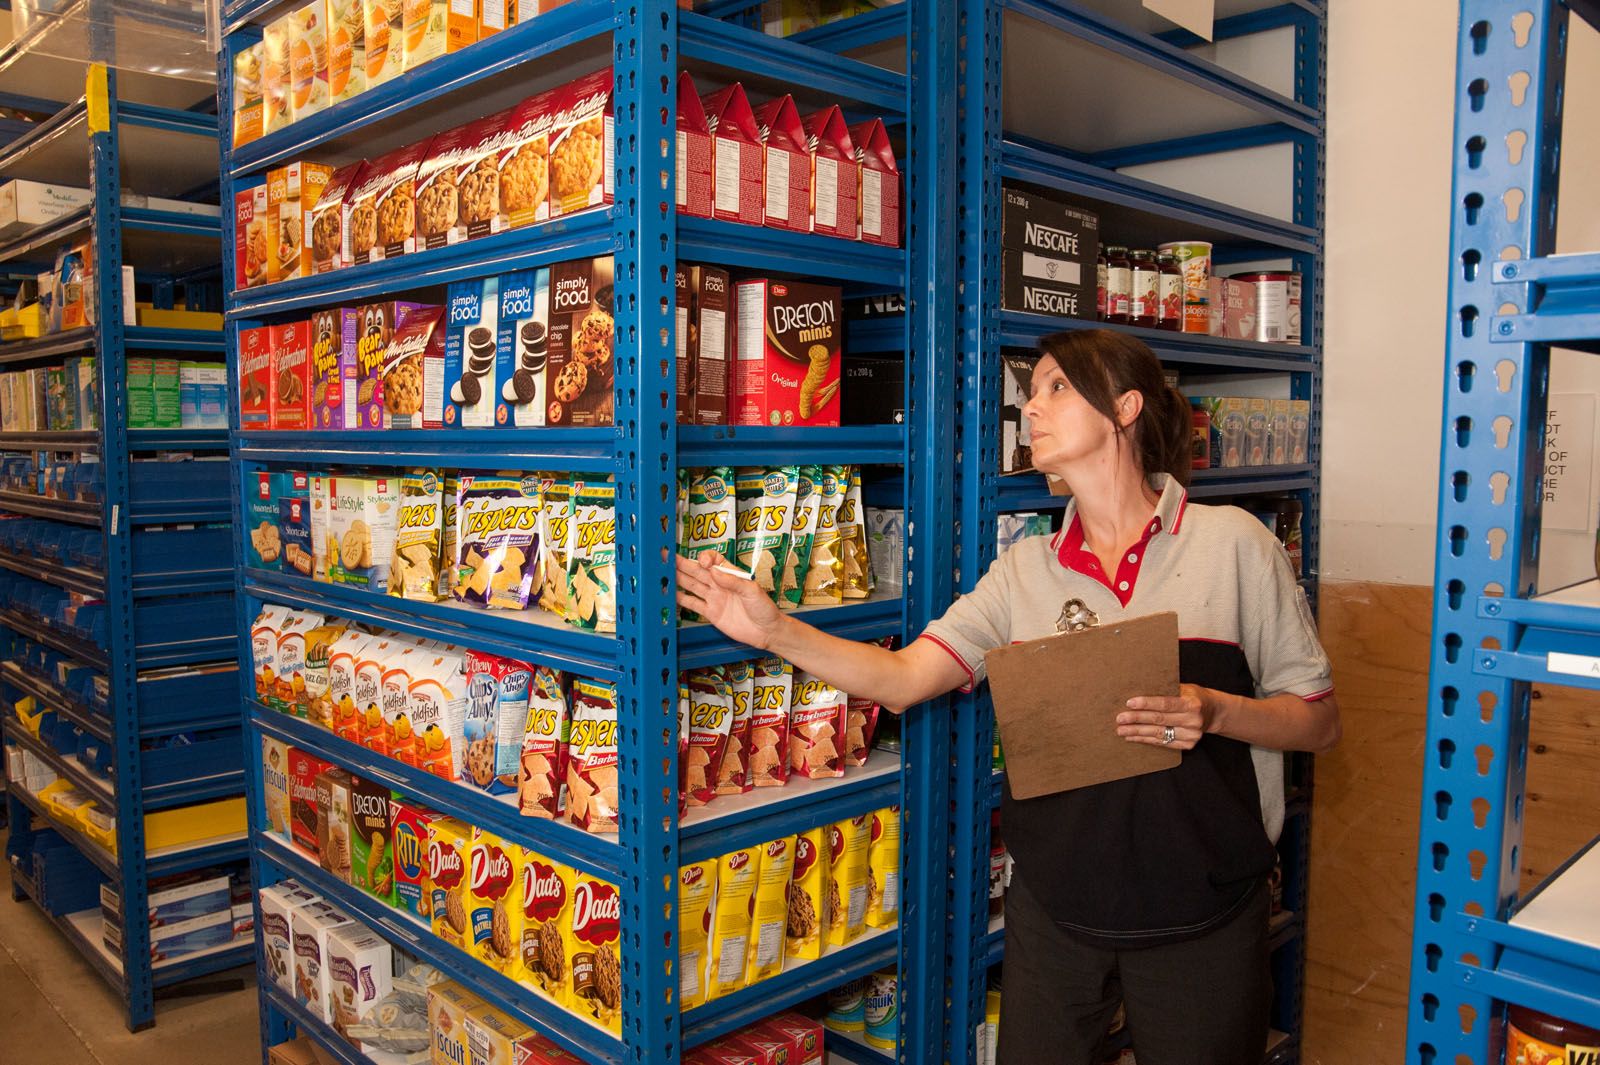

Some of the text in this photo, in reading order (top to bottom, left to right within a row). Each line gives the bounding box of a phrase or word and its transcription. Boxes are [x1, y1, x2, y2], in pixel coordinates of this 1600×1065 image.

[1024, 220, 1079, 255] NESCAFÉ
[503, 287, 532, 302] simply
[556, 276, 588, 293] simply
[705, 281, 724, 293] food
[452, 294, 479, 307] simply
[1024, 286, 1078, 315] NESCAFÉ
[773, 300, 836, 334] BRETON
[551, 333, 563, 345] chip
[799, 322, 833, 343] minis
[771, 373, 798, 389] Original
[1549, 452, 1567, 463] OF
[355, 681, 380, 703] Goldfish
[383, 691, 408, 714] Goldfish
[794, 709, 837, 726] Barbecue
[353, 792, 387, 816] BRETON
[365, 814, 387, 830] minis
[395, 829, 421, 873] RITZ
[429, 842, 463, 880] Dad's
[471, 845, 511, 890] Dad's
[523, 861, 562, 908] Dad's
[573, 881, 620, 932] Dad's
